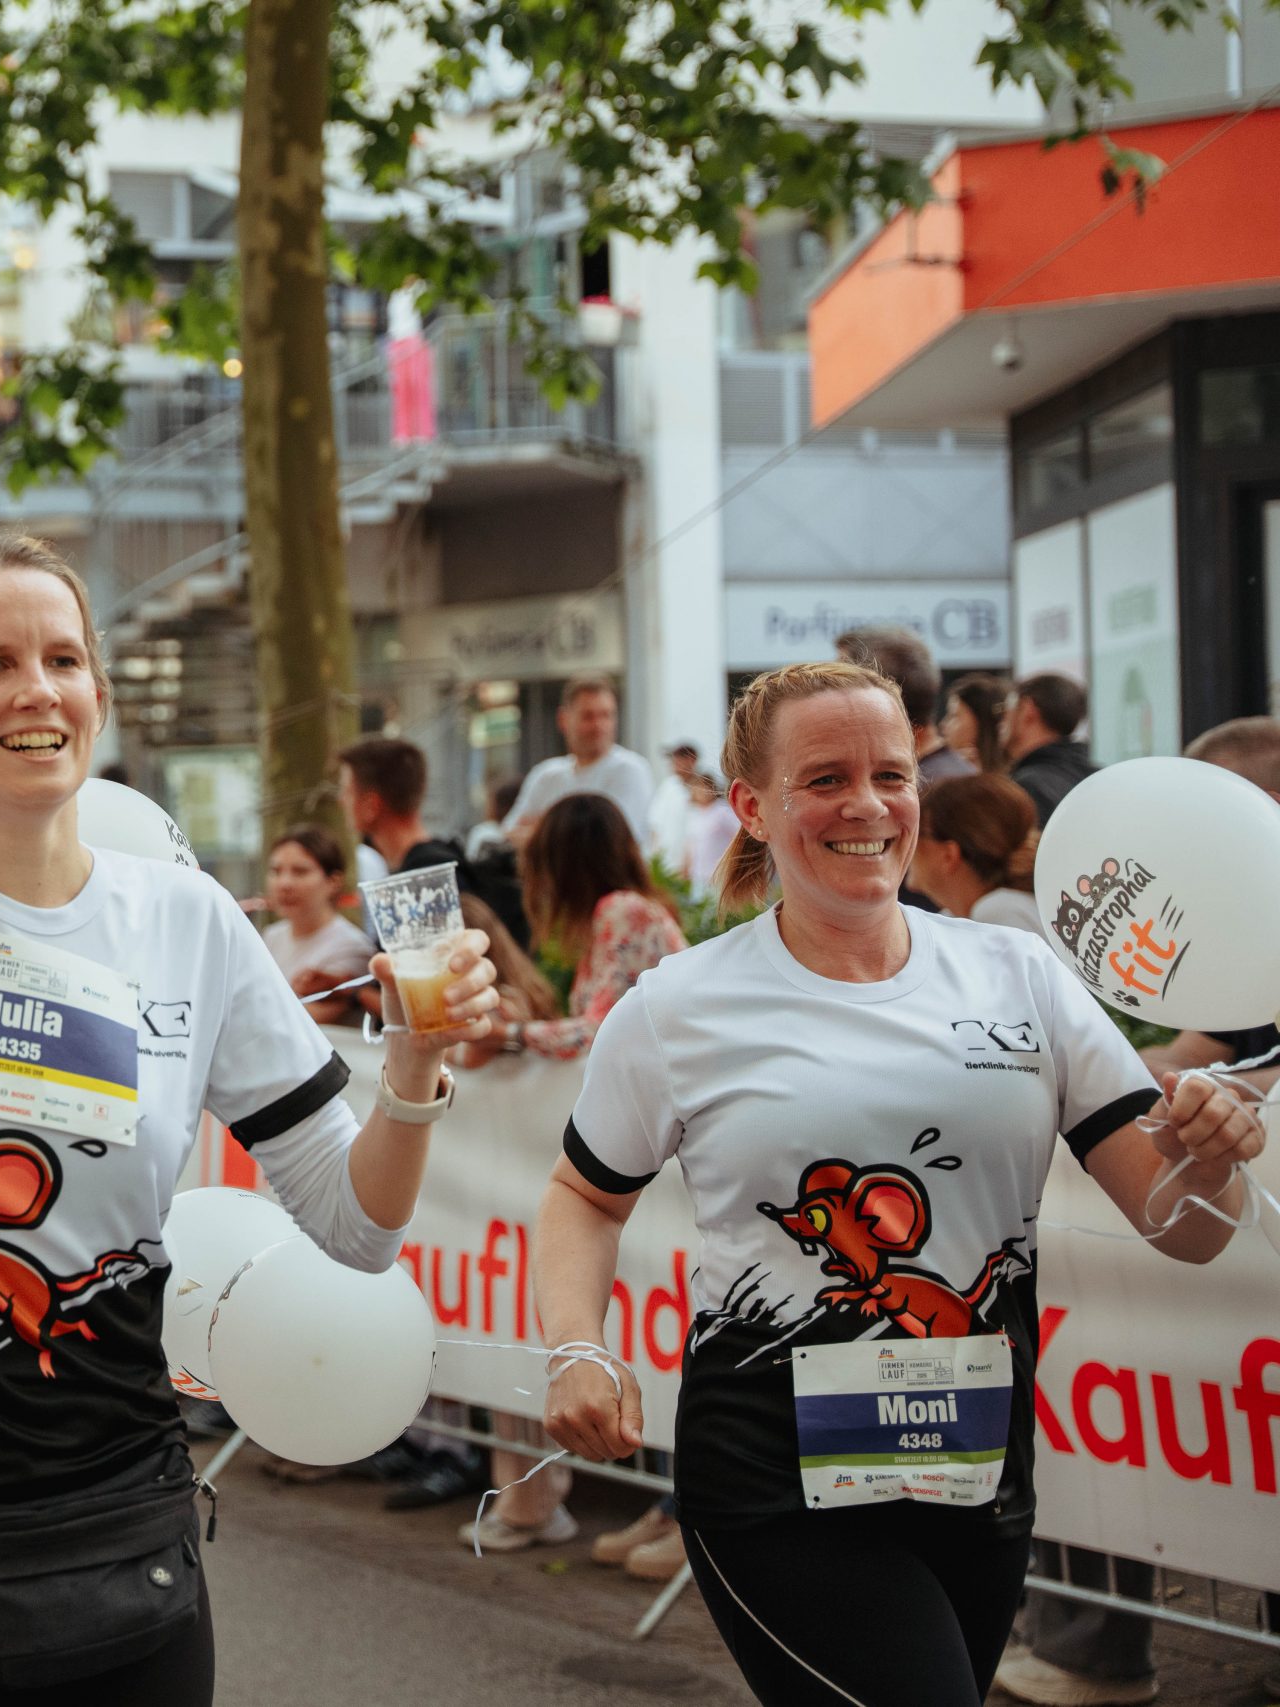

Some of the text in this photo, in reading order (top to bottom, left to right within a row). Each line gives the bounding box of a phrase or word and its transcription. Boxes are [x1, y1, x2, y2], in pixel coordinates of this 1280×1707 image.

[1108, 917, 1177, 996] fit
[964, 1061, 1007, 1071] tierklinik
[882, 1369, 905, 1380] LAUF
[877, 1392, 959, 1425] Moni
[898, 1432, 943, 1449] 4348
[894, 1456, 922, 1464] STARTZEIT
[835, 1473, 852, 1484] dm
[922, 1473, 945, 1482] BOSCH
